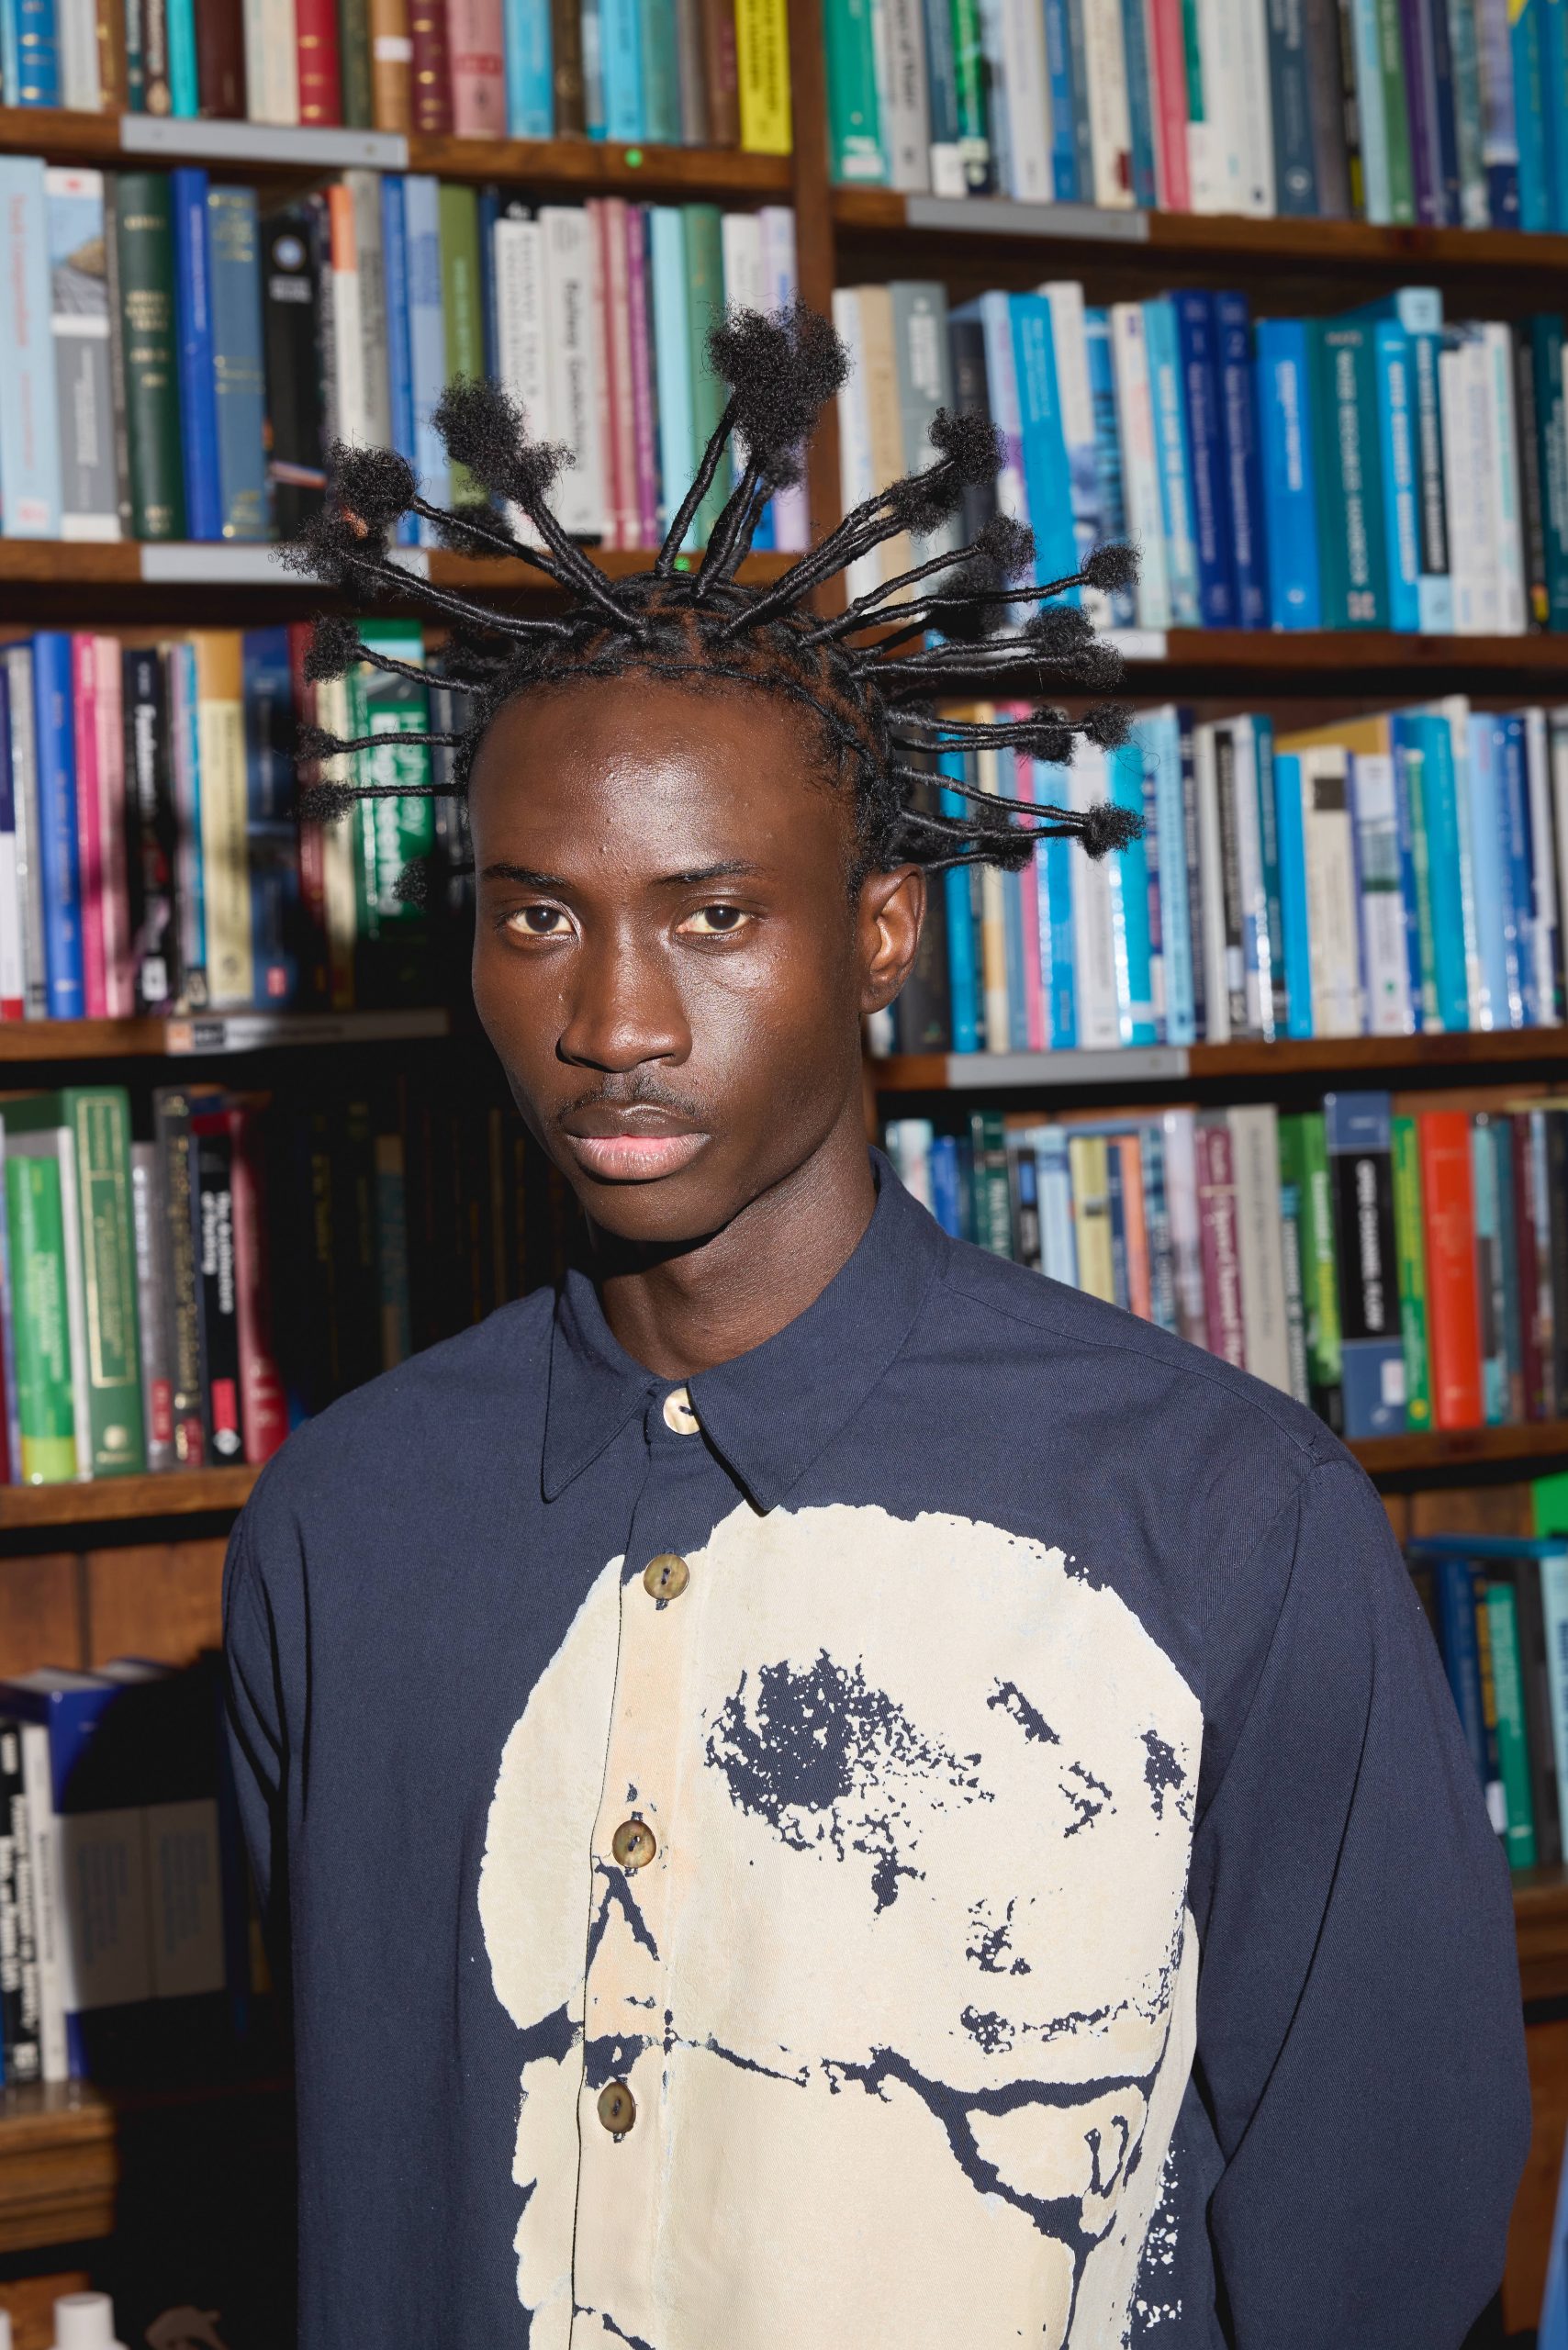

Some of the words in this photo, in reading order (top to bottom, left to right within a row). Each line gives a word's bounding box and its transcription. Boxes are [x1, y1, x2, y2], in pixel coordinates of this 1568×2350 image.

[397, 711, 428, 835] Hghay
[369, 712, 406, 916] Egieering
[1358, 1162, 1374, 1206] OPEN
[1361, 1208, 1377, 1281] CHANNEL
[1365, 1284, 1382, 1330] FLOW
